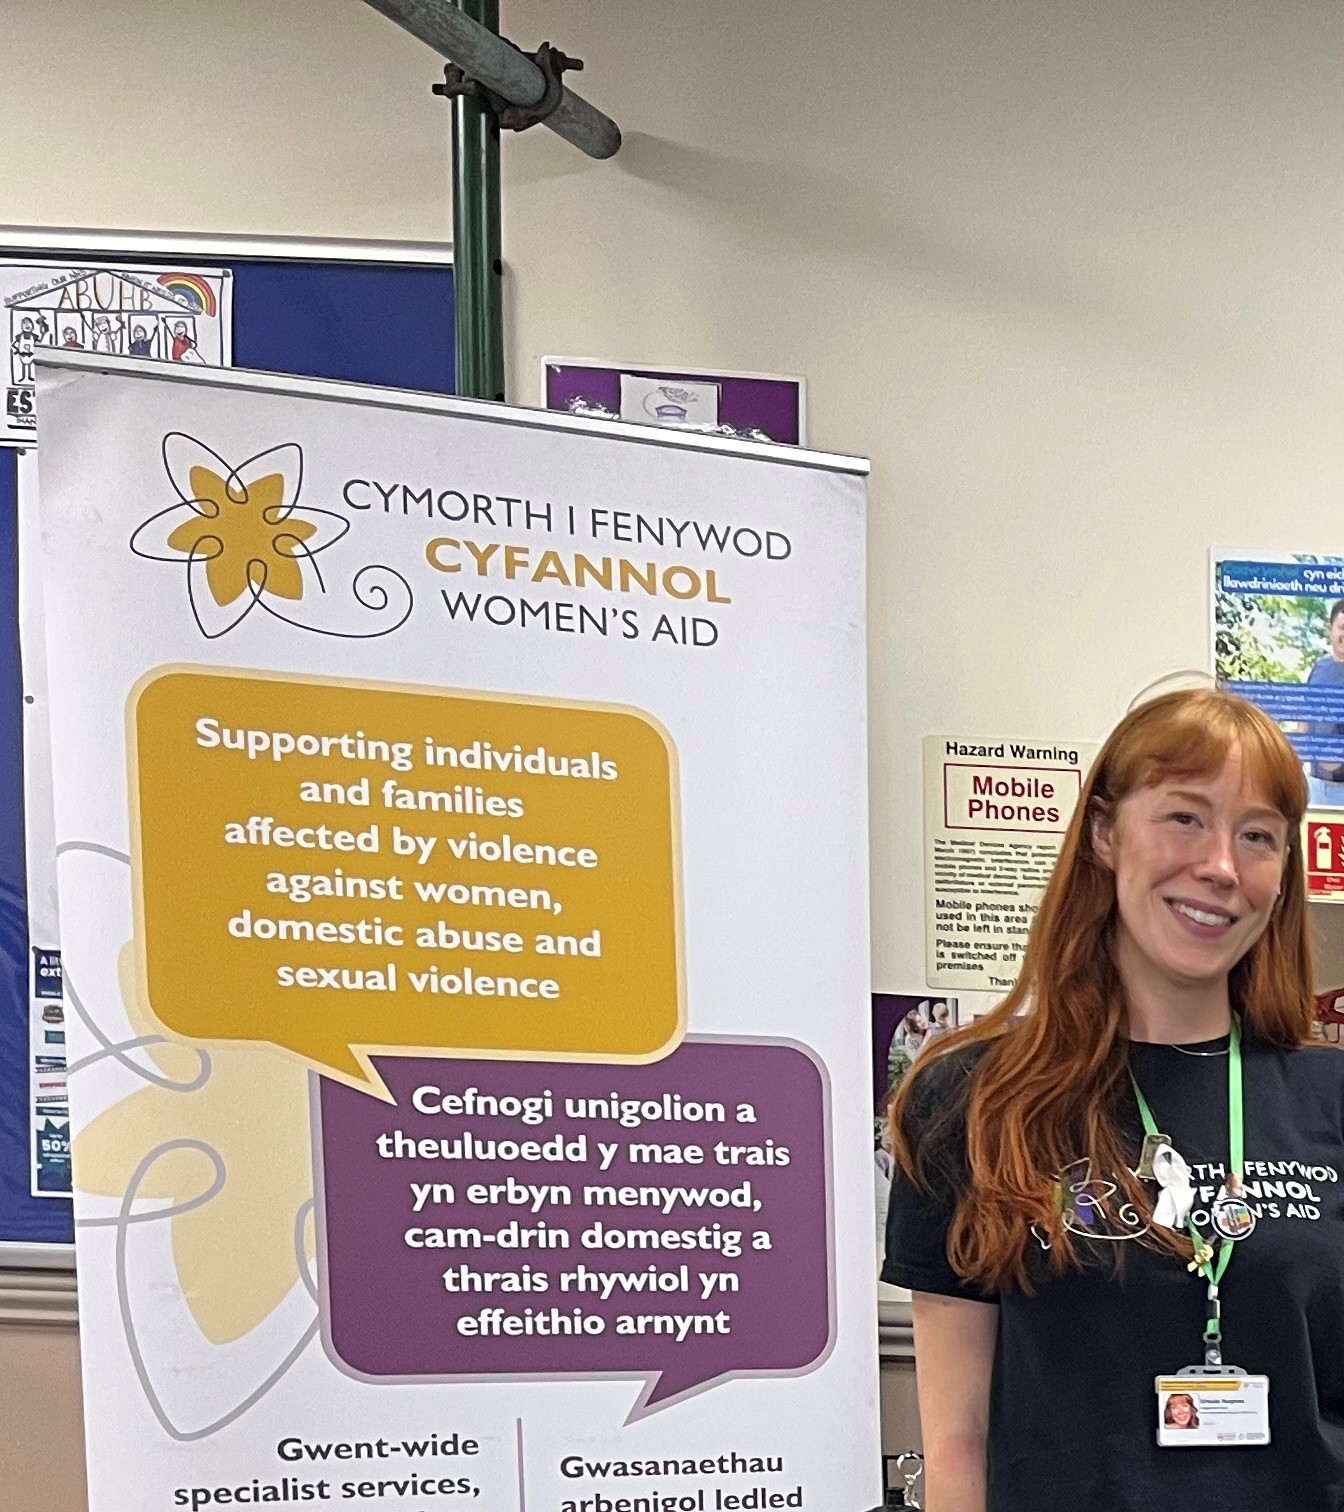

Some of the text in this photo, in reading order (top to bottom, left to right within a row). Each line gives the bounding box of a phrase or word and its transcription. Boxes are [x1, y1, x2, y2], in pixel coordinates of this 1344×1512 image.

[343, 479, 791, 560] CYMORTH I FENYWOD
[425, 537, 731, 604] CYFANNOL
[1223, 571, 1302, 592] llawdriniaeth
[1305, 581, 1330, 593] neu
[1303, 568, 1325, 582] cyn
[441, 590, 718, 647] WOMEN'S AID
[195, 718, 618, 780] Supporting individuals
[945, 741, 1078, 765] Hazard Warning
[300, 778, 524, 818] and families
[972, 776, 1055, 798] Mobile
[968, 800, 1060, 822] Phones
[225, 816, 598, 868] affected by violence
[266, 869, 562, 915] against women,
[228, 910, 600, 958] domestic abuse and
[277, 963, 560, 999] sexual violence
[412, 1085, 756, 1128] Cefnogi unigolion a
[376, 1130, 790, 1170] theuluoedd y mae trais
[1245, 1161, 1338, 1183] FENYWOD
[411, 1177, 762, 1214] yn erbyn menywod,
[1286, 1203, 1321, 1220] AID
[405, 1221, 771, 1257] cam-drin domestig a
[443, 1264, 738, 1300] thrais rhywiol yn
[457, 1308, 730, 1342] effeithio arnynt
[277, 1433, 479, 1461] Gwent-wide
[560, 1452, 783, 1479] Gwasanaethau
[174, 1473, 481, 1512] specialist services,
[716, 1486, 802, 1510] ledled
